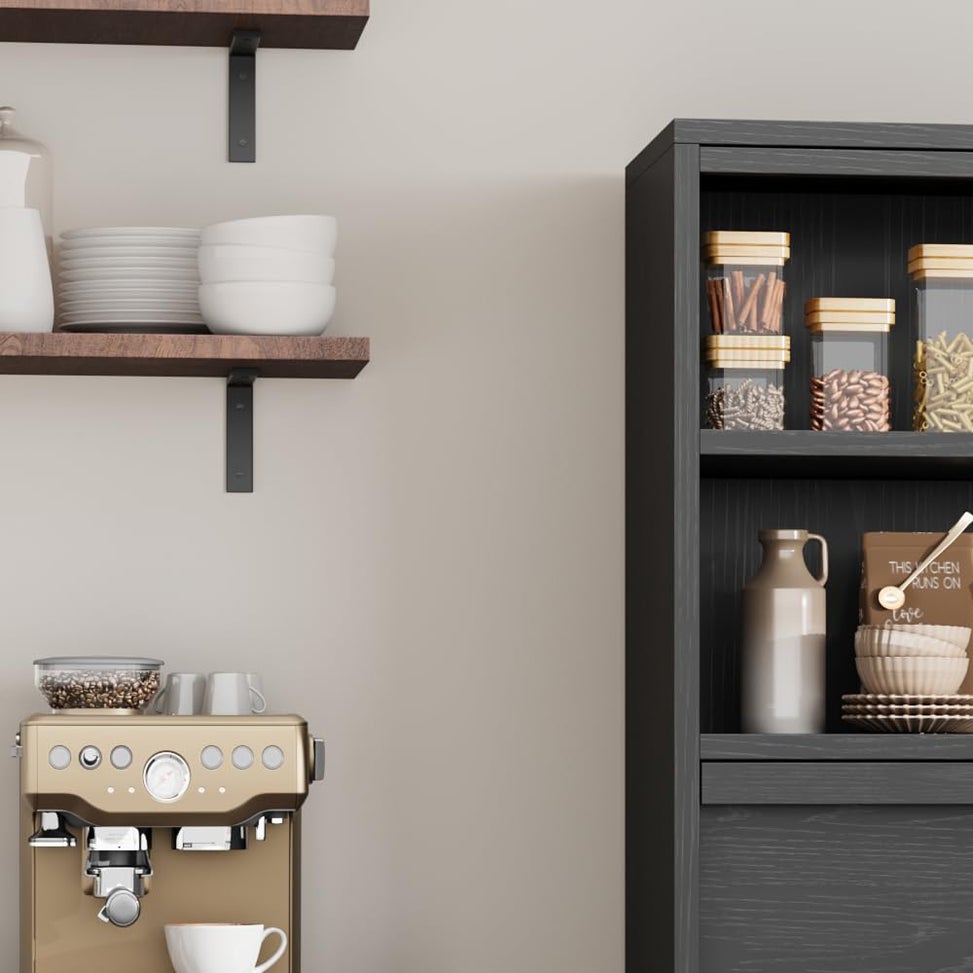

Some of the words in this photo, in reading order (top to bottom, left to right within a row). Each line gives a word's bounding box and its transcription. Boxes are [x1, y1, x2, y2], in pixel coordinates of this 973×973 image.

[888, 561, 912, 574] THIS
[914, 561, 961, 574] KCHEN
[912, 576, 940, 590] RUNS
[943, 576, 962, 590] ON
